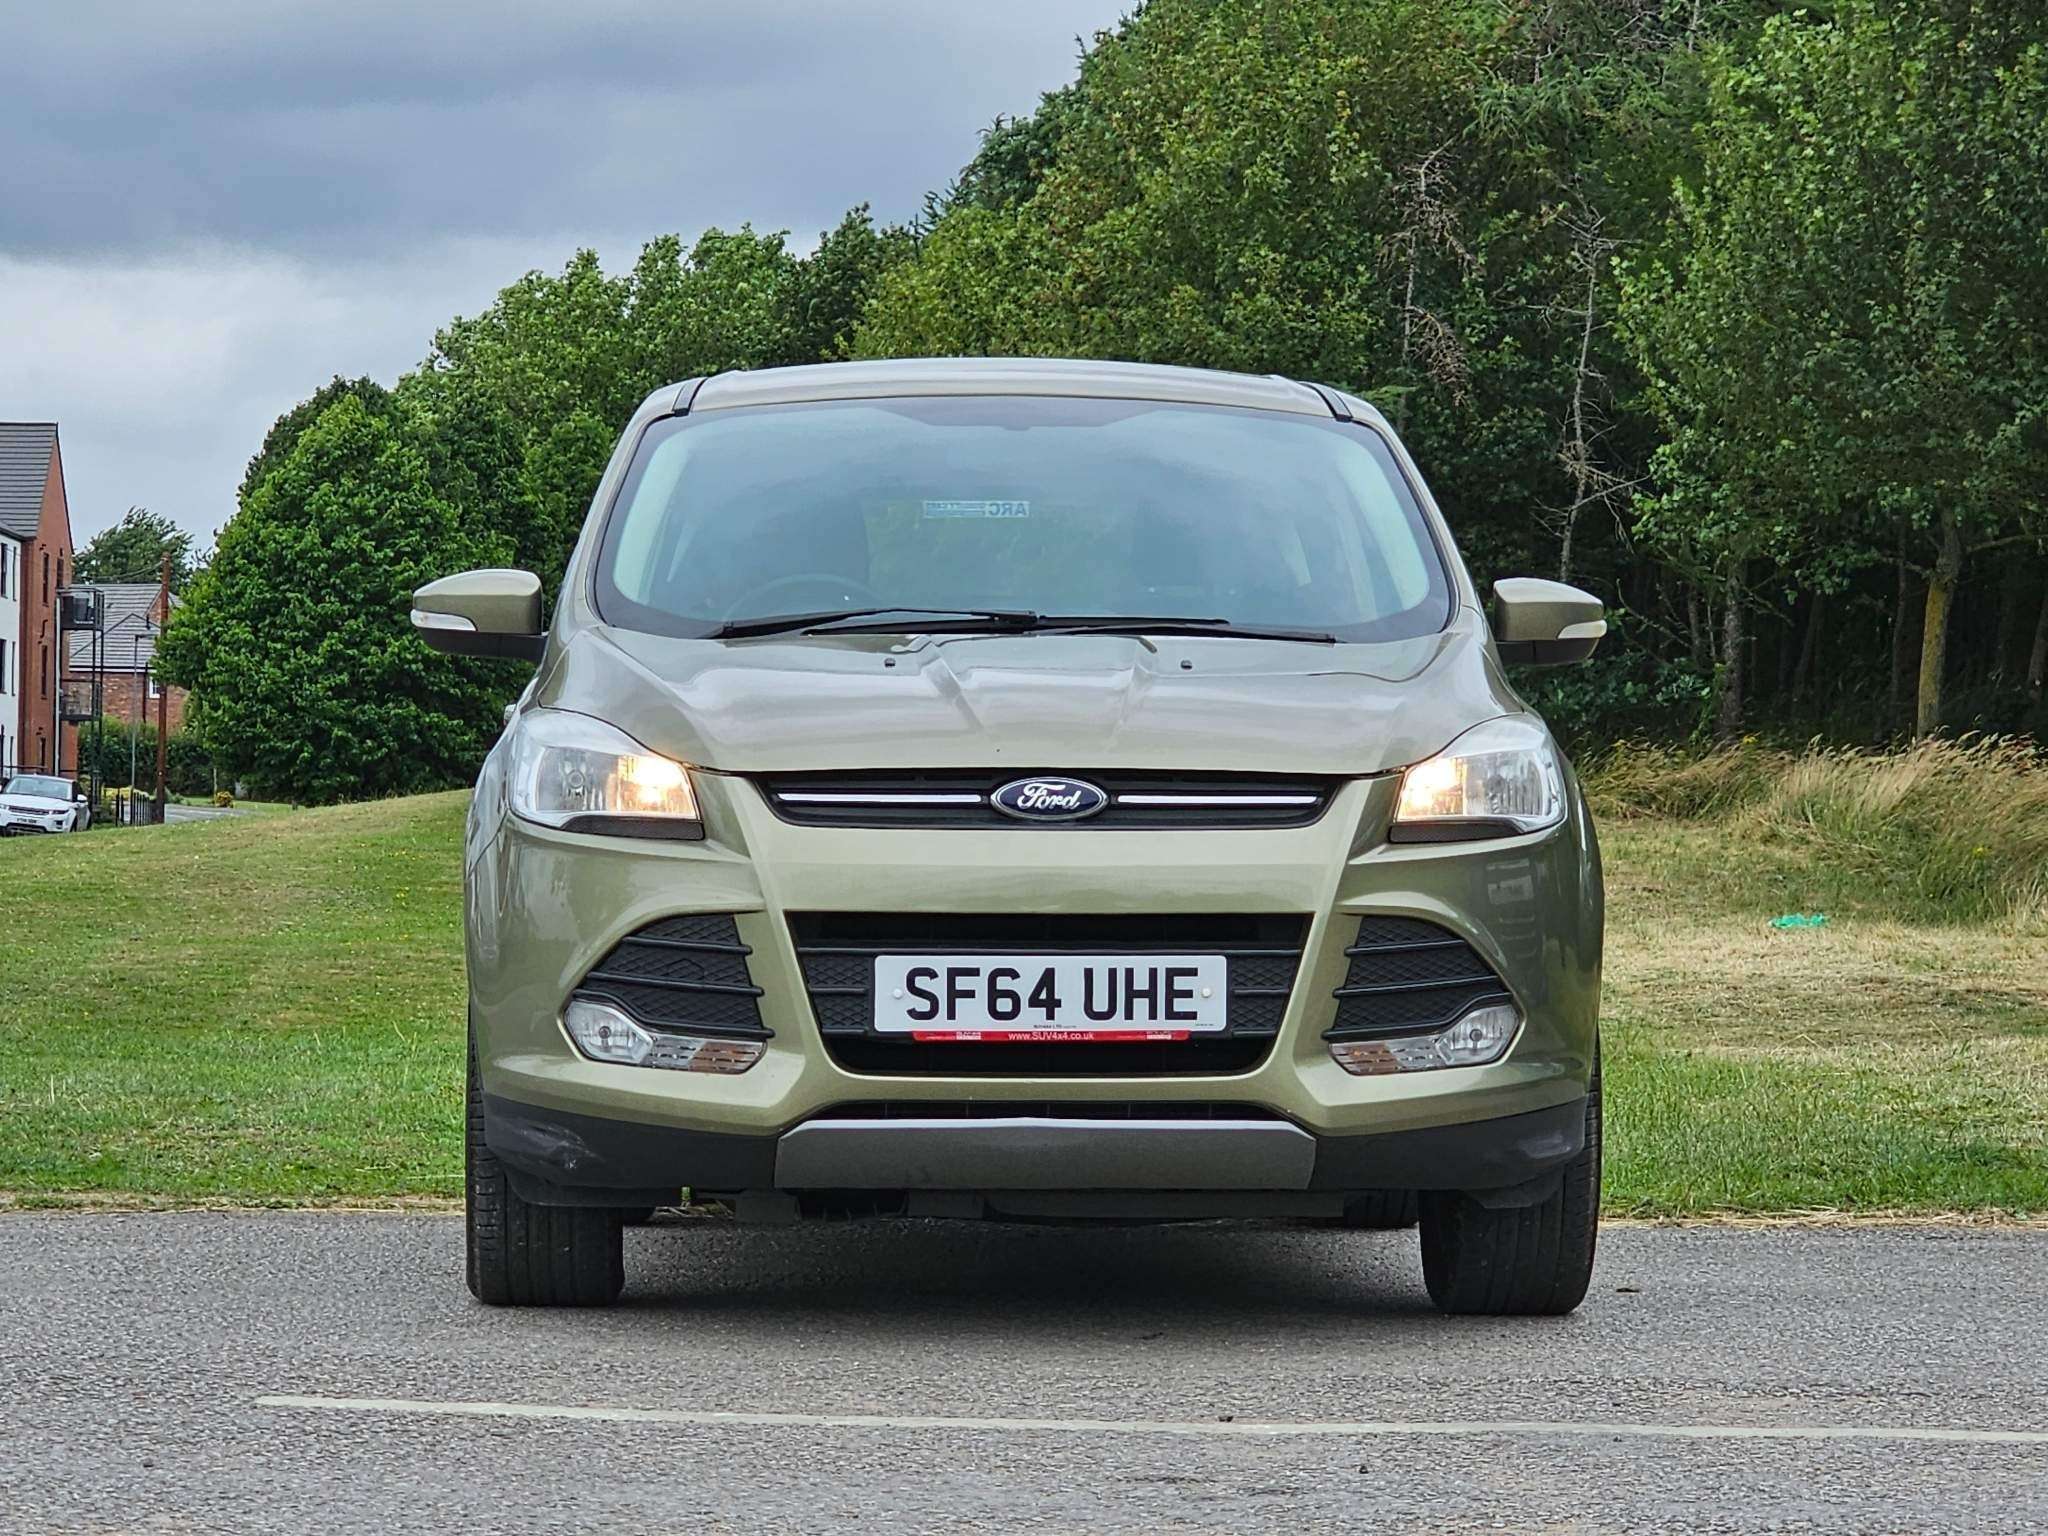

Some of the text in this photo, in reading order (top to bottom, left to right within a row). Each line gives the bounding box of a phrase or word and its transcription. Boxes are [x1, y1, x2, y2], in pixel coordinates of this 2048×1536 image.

[1017, 783, 1081, 809] Ford
[905, 967, 1199, 1021] SF64 UHE
[1008, 1031, 1095, 1041] www.SUV4x4.co.uk
